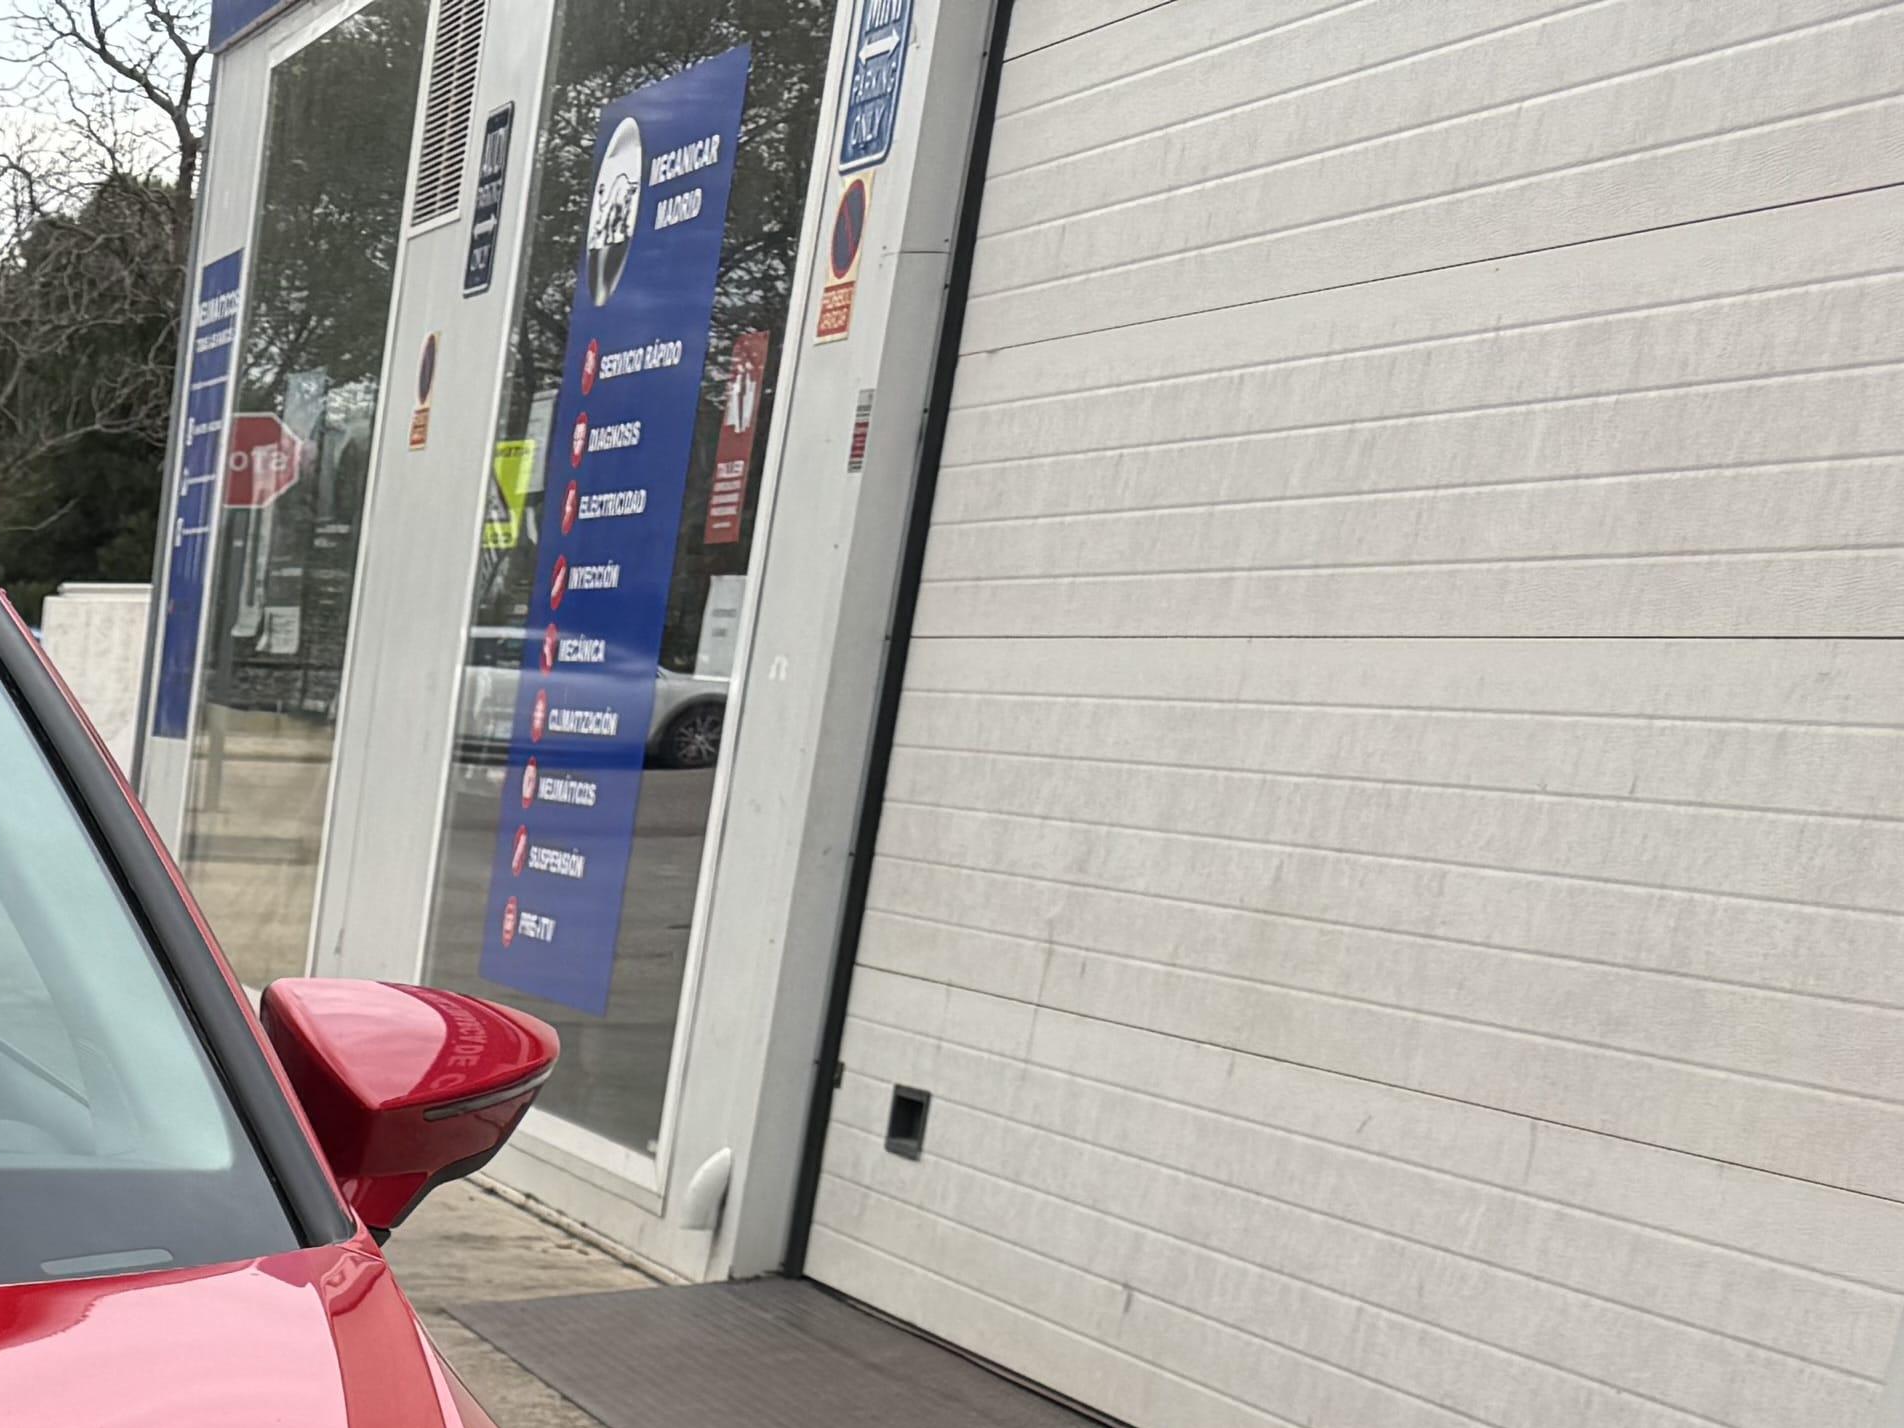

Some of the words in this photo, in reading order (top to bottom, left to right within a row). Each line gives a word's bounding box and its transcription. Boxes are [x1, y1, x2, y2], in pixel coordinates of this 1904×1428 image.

[851, 105, 886, 148] ONLY
[648, 134, 720, 187] MECANICAR
[654, 188, 702, 230] MADRID
[599, 347, 644, 380] SERVICIO
[644, 338, 682, 370] RÁPIDO
[588, 420, 641, 452] DIAGNOSIS
[578, 489, 647, 520] ELECTRICIDAD
[568, 560, 620, 590] INYECCIÓN
[558, 634, 606, 663] MECÁNICA
[548, 706, 619, 736] CLIMATIZACIÓN
[537, 774, 596, 806] NEUMÁTICOS
[528, 845, 585, 878] SUSPENSIÓN
